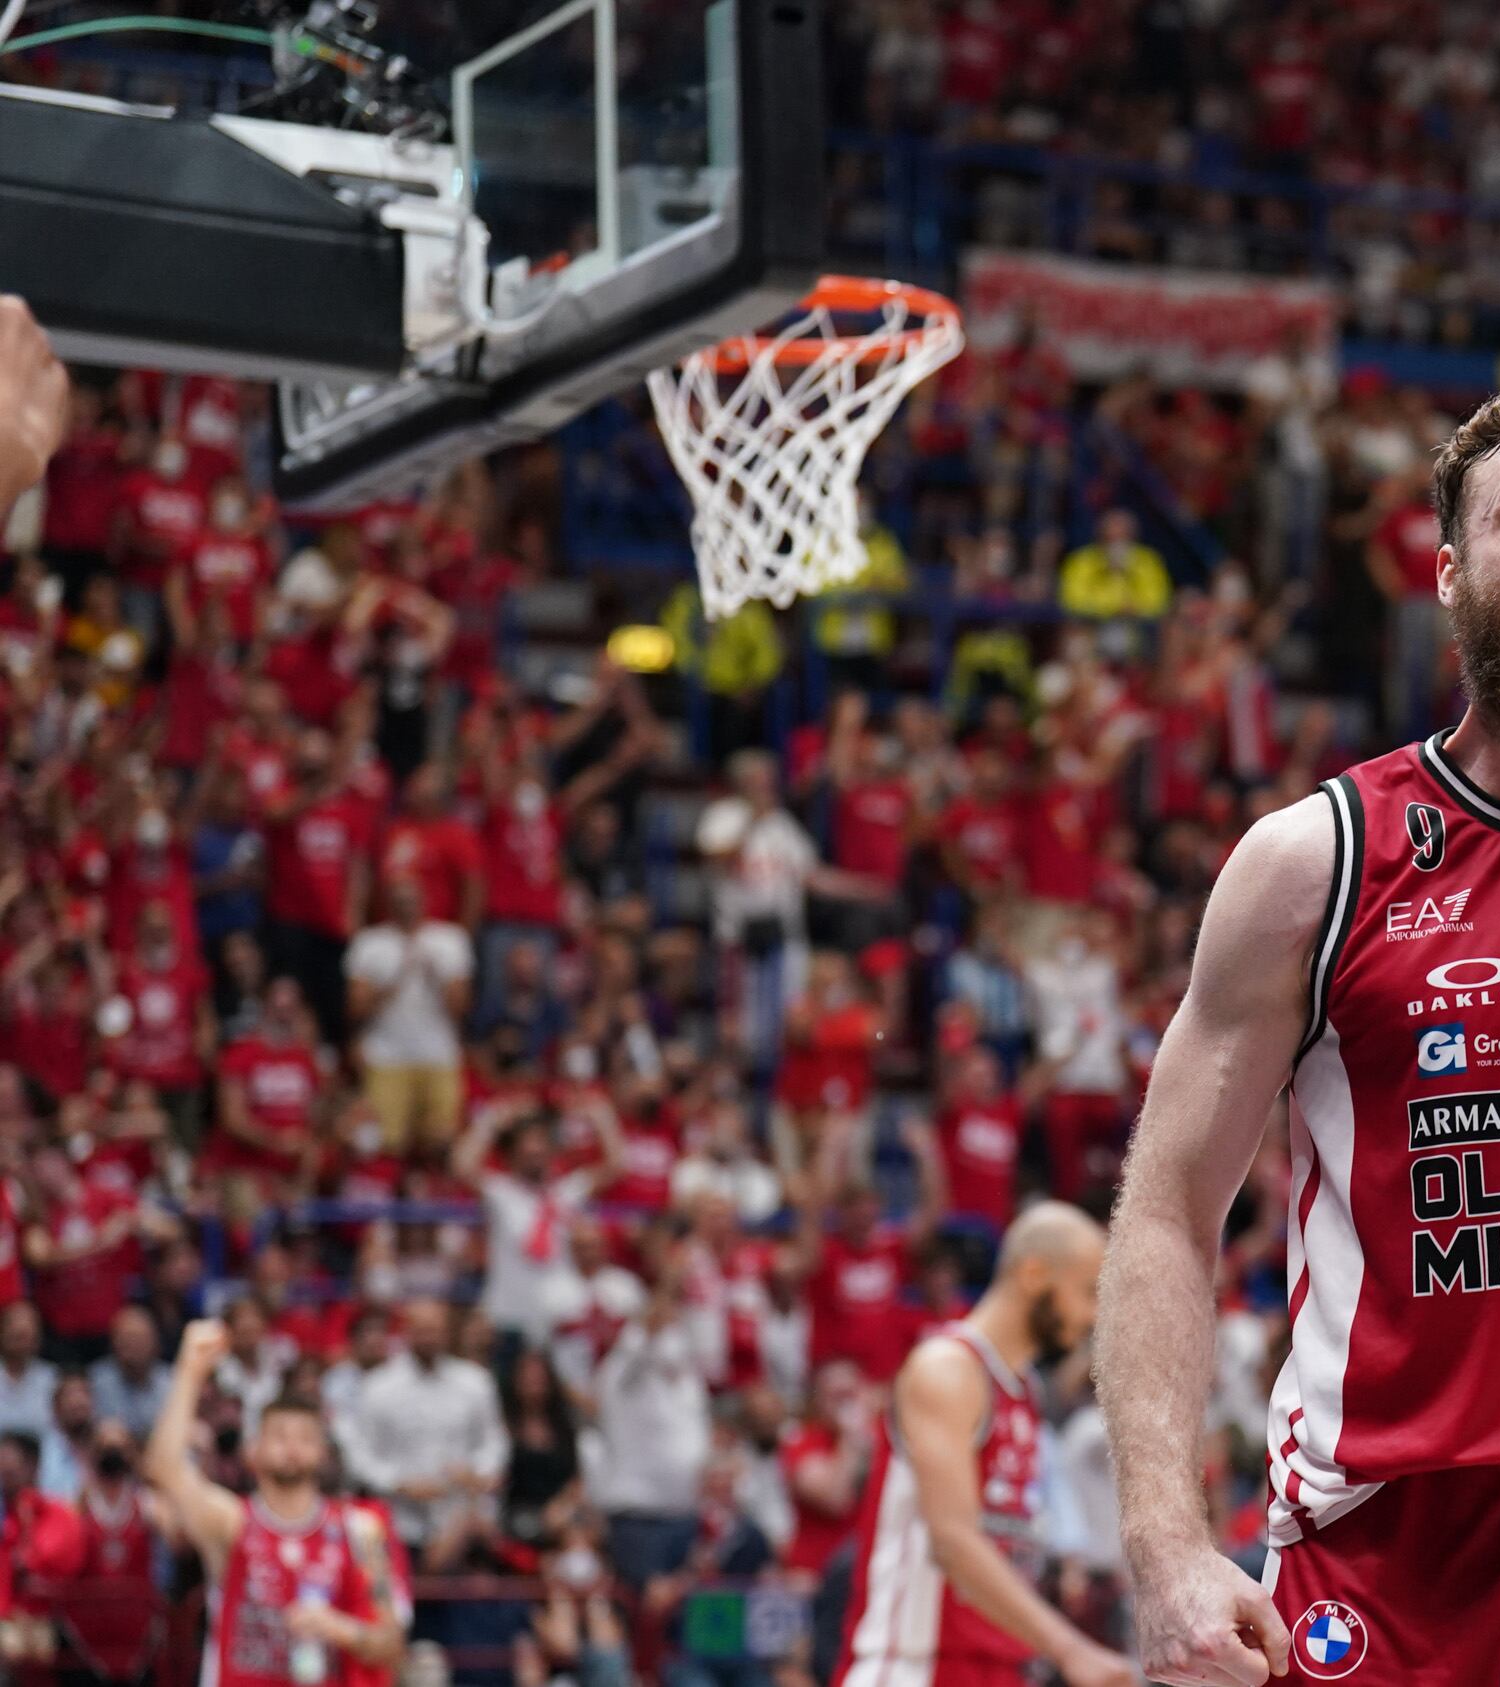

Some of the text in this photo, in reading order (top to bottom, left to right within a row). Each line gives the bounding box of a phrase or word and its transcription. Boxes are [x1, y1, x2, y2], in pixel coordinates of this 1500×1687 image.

[1405, 802, 1446, 872] 9
[1386, 921, 1474, 943] EMPORIO ARMANI
[1418, 1030, 1467, 1072] Gi
[1476, 1059, 1492, 1067] YOUR
[1306, 1604, 1359, 1629] BMW
